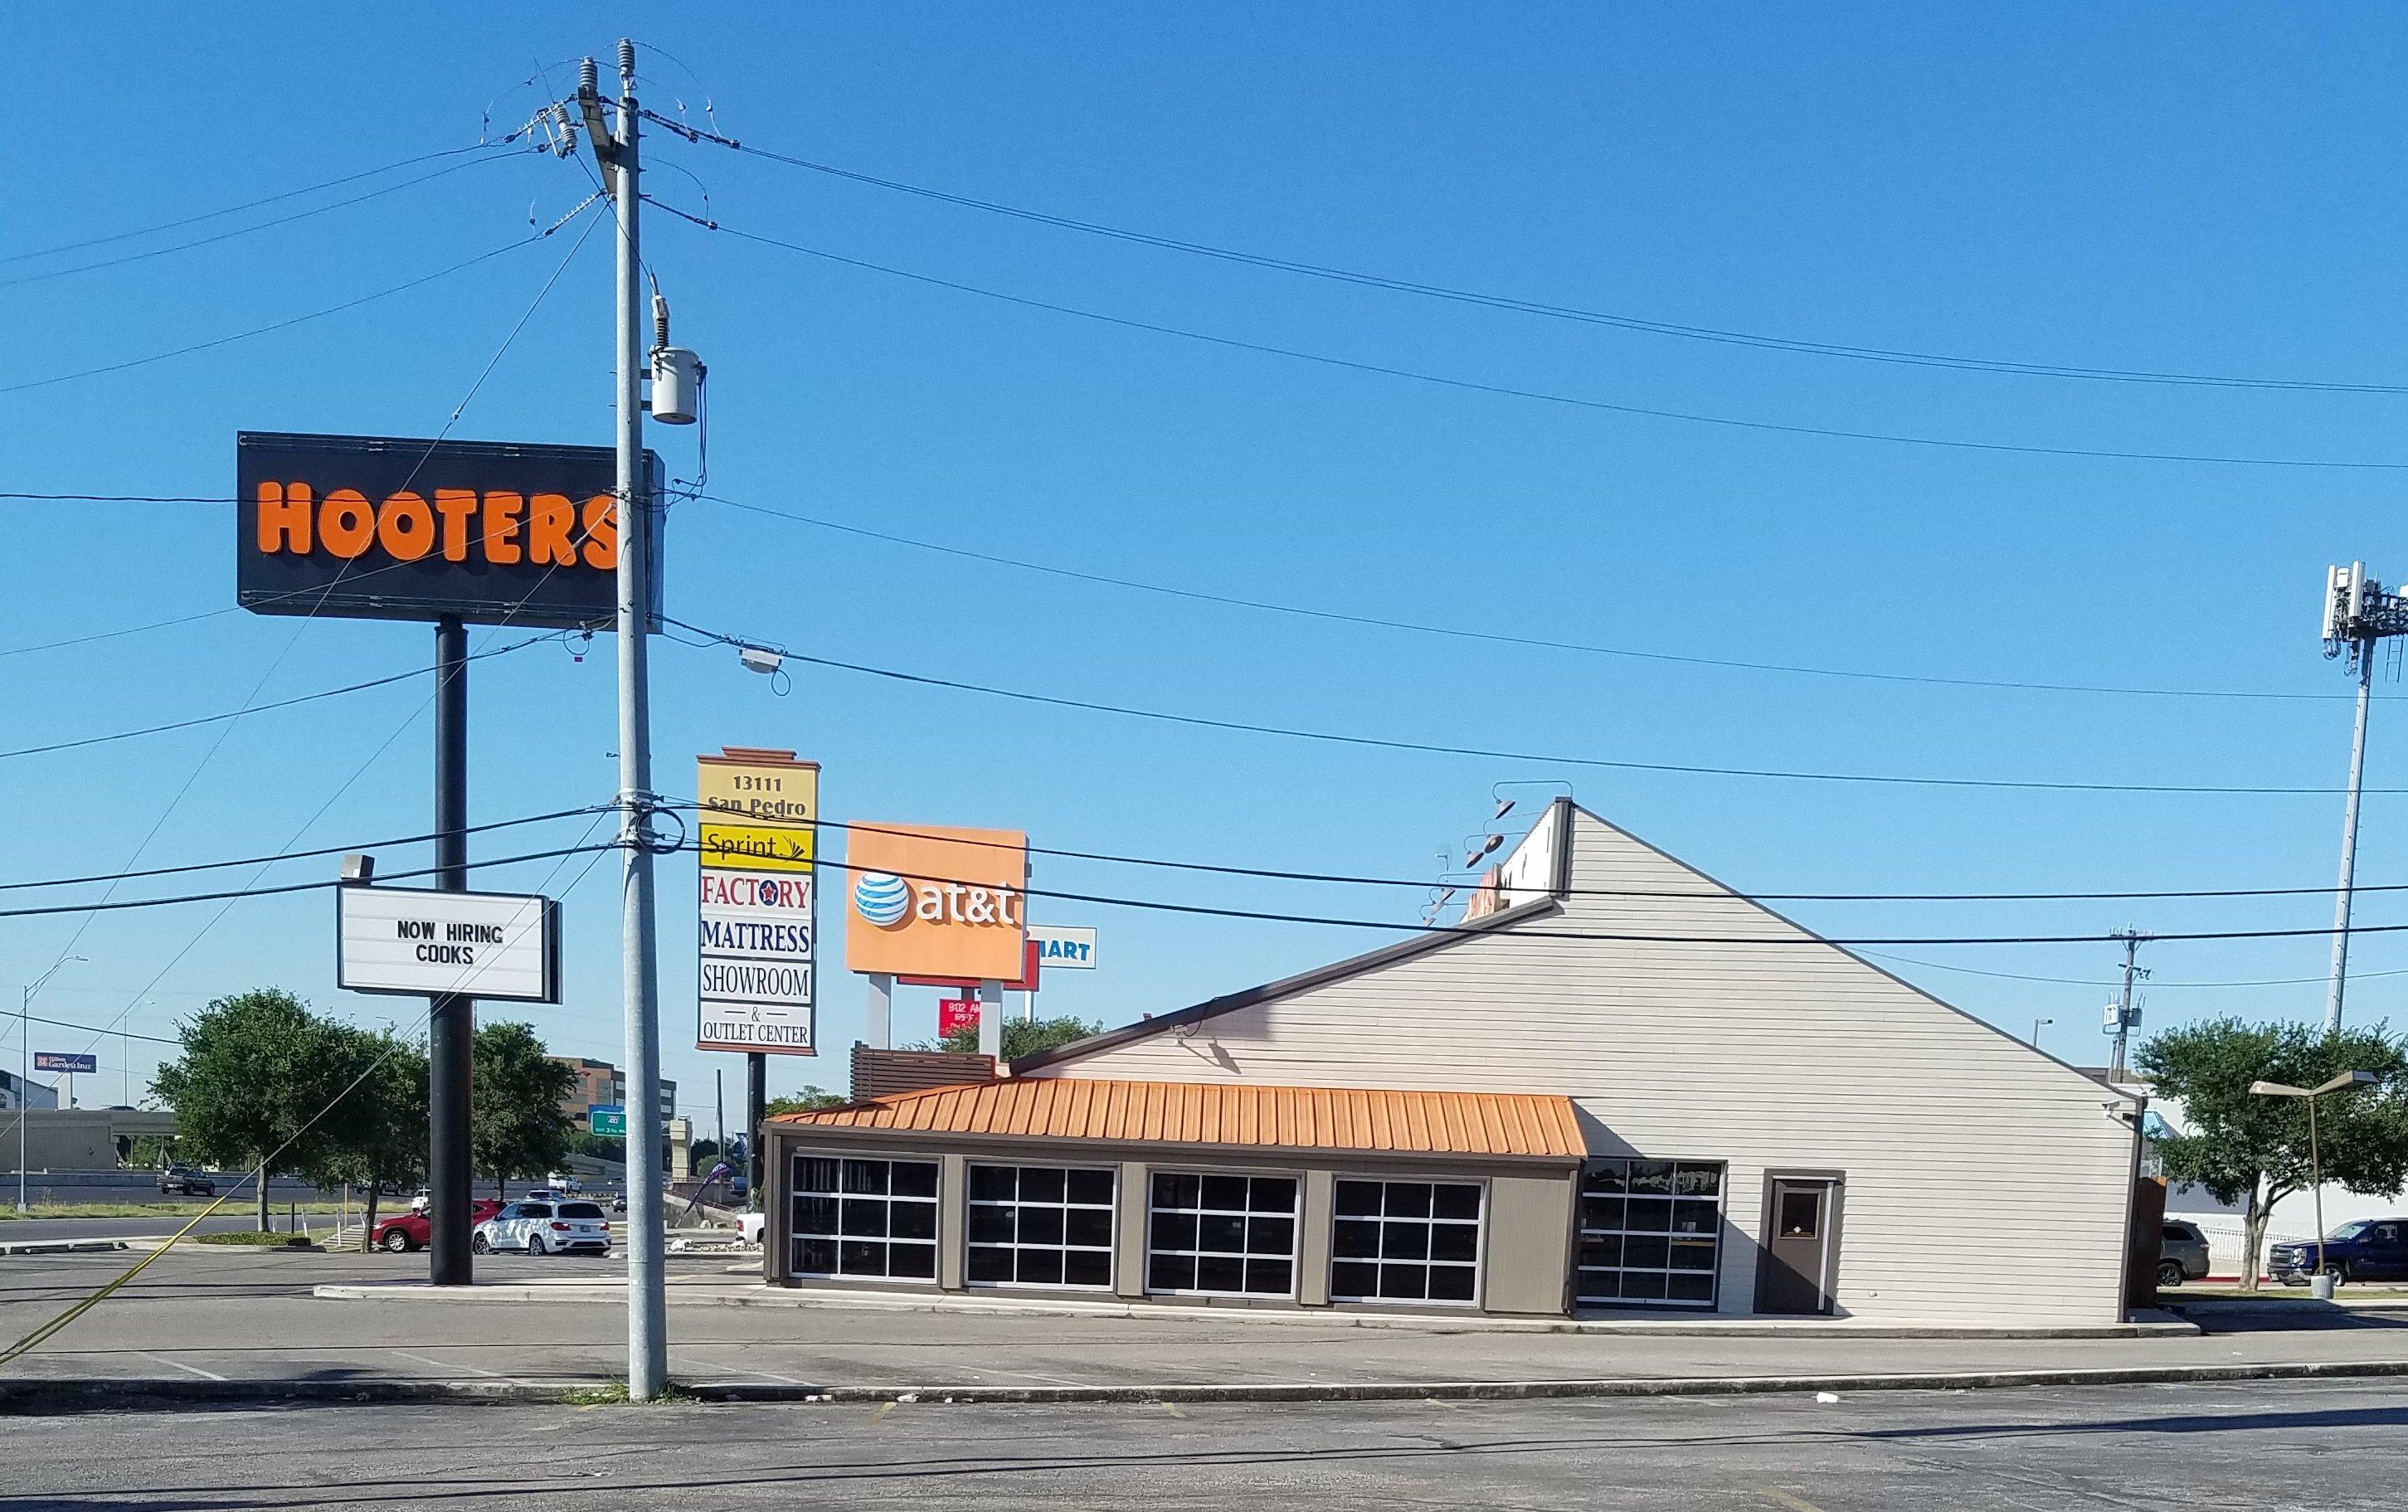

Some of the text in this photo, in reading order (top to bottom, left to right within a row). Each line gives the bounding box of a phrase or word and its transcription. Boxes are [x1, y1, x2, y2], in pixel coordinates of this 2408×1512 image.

[257, 479, 618, 571] HOOTERS
[733, 775, 781, 792] 13111
[708, 796, 806, 816] San Pedro
[708, 834, 777, 860] Sprint
[702, 876, 810, 909] FACTORY
[397, 920, 503, 944] NOW HIRING
[701, 920, 810, 953] MATTRESS
[416, 944, 474, 965] COOKS
[703, 964, 810, 996] SHOWROOM
[752, 1006, 761, 1023] &
[703, 1022, 808, 1043] OUTLET CENTER
